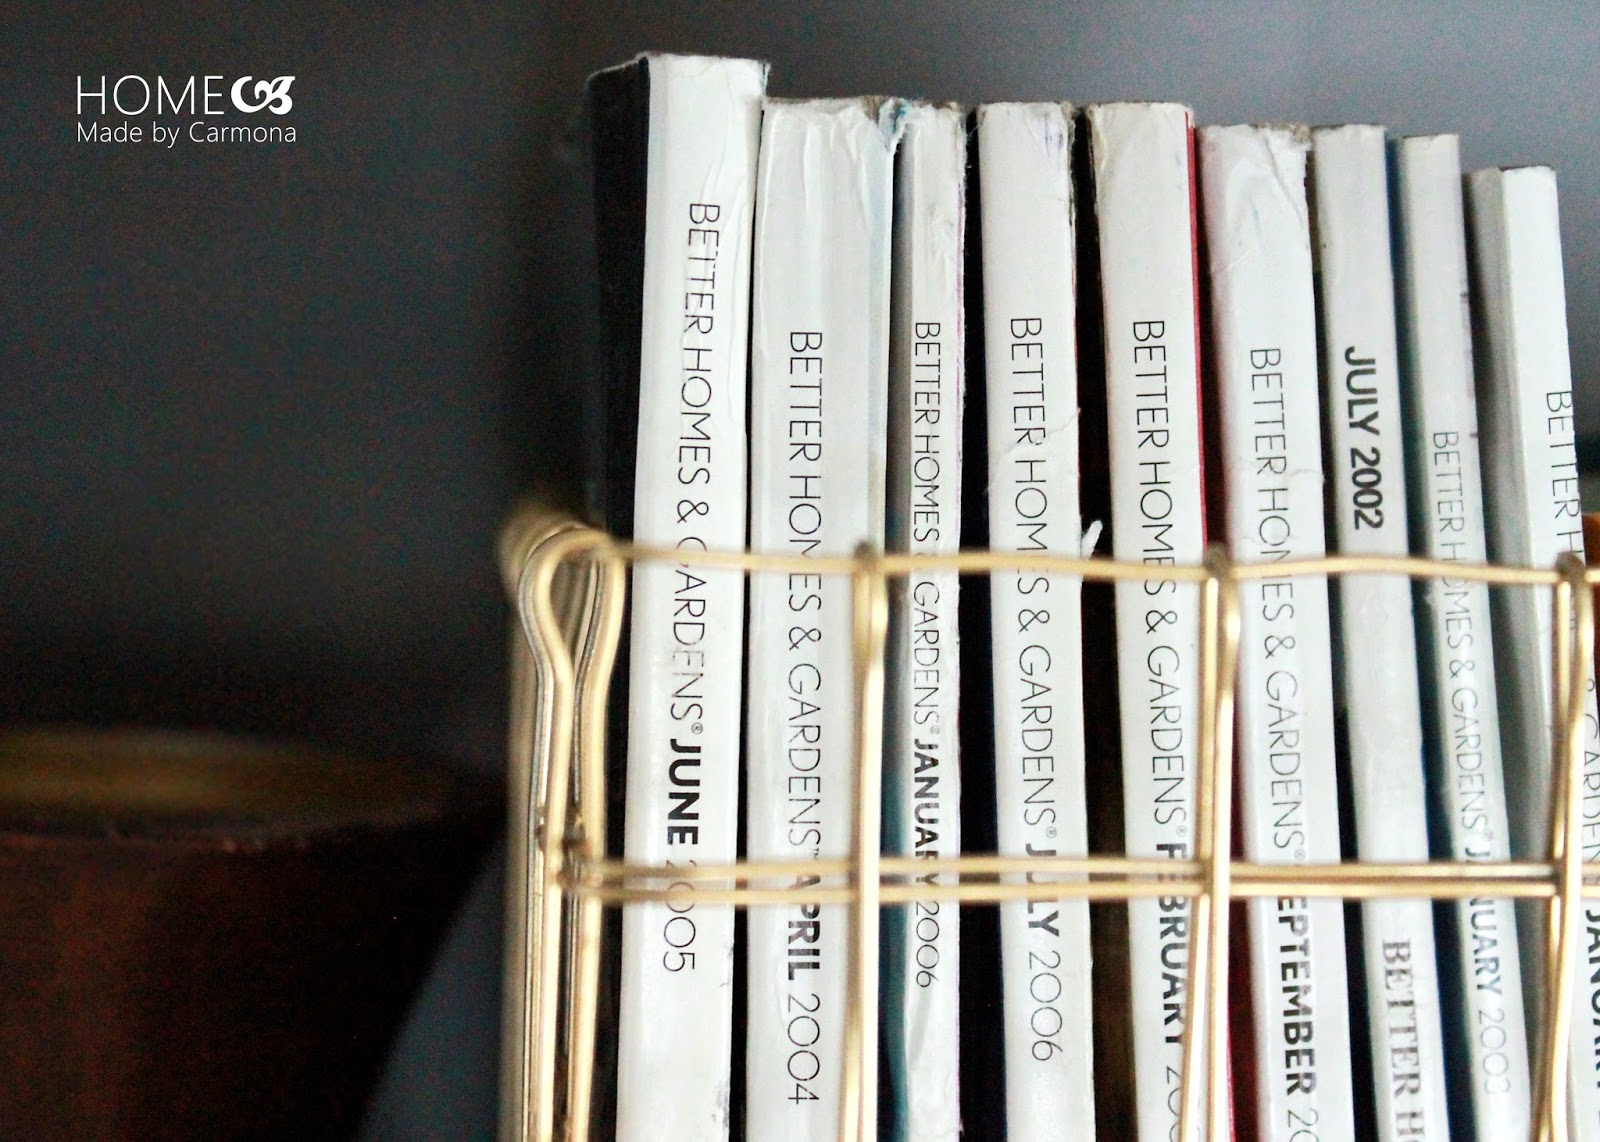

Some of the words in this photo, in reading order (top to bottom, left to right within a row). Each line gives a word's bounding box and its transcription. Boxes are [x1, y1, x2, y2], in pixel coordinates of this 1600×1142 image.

[684, 203, 720, 334] BETTER
[678, 348, 713, 484] HOMES
[790, 332, 823, 461] BETTER
[915, 322, 941, 425] BETTER
[1011, 318, 1046, 446] BETTER
[1133, 321, 1170, 448] BETTER
[1250, 348, 1287, 475] BETTER
[1344, 346, 1380, 436] JULY
[914, 435, 940, 541] HOMES
[1350, 446, 1384, 530] 2002
[1546, 390, 1582, 519] BETTER
[677, 499, 709, 523] &
[1015, 460, 1050, 594] HOMS
[789, 626, 822, 650] &
[1018, 609, 1050, 633] &
[1145, 610, 1177, 634] &
[1264, 635, 1296, 659] &
[667, 738, 702, 845] JUNE
[1433, 431, 1465, 533] BETTER
[1450, 659, 1475, 678] &
[1478, 1008, 1511, 1095] 2003
[663, 859, 697, 972] 005
[916, 900, 940, 988] 2006
[787, 993, 821, 1104] 2004
[1029, 950, 1063, 1061] 2006
[1277, 894, 1317, 1096] EPTEMBER
[1382, 938, 1421, 1098] BETTER
